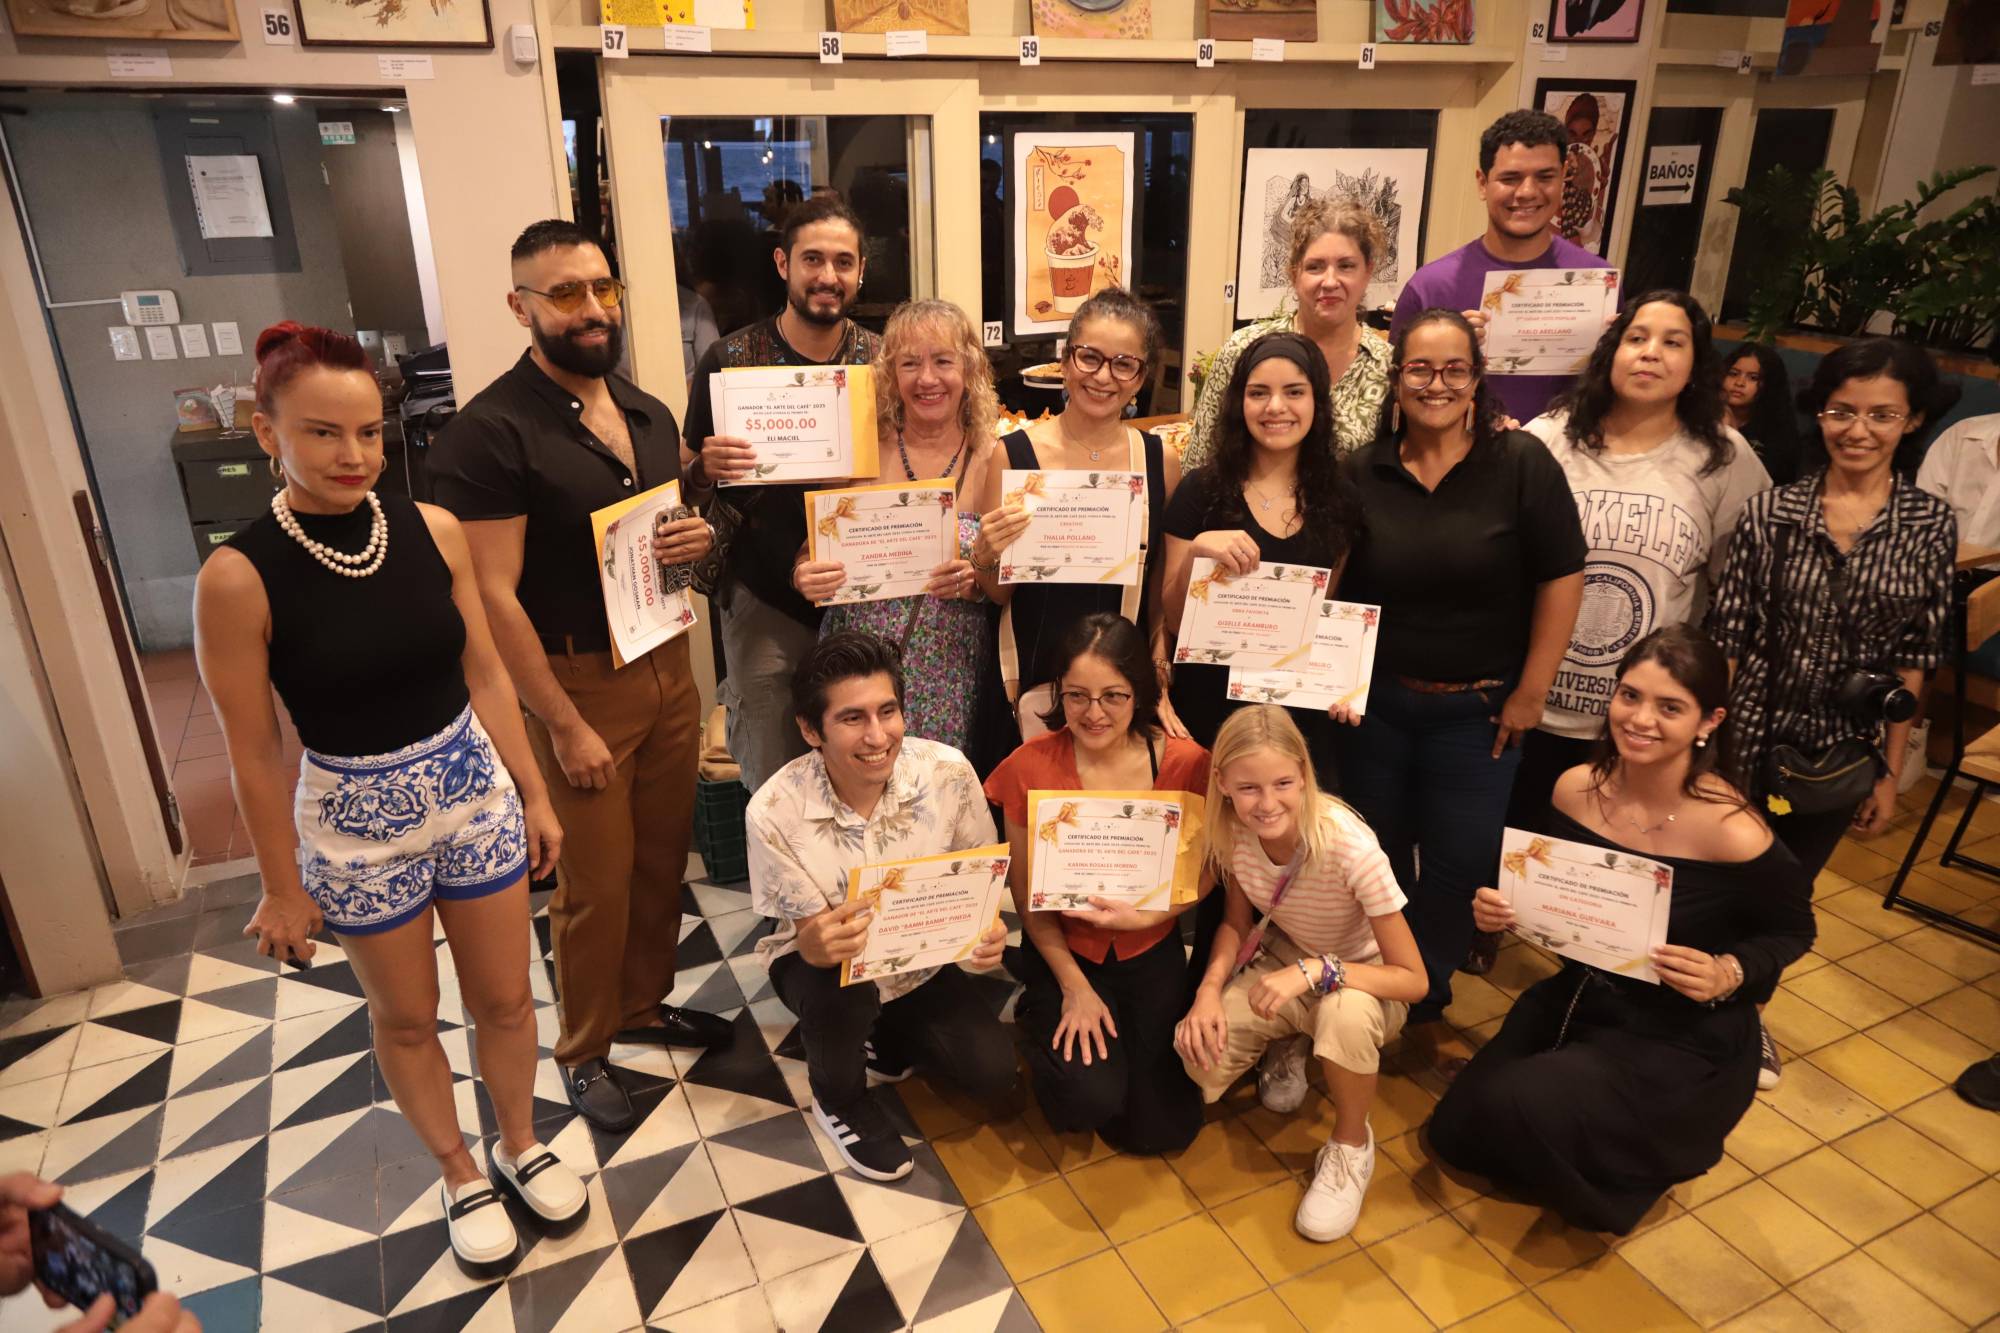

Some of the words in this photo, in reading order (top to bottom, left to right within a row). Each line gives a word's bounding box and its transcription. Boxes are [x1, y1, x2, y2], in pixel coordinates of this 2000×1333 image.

[265, 14, 291, 37] 56
[1532, 23, 1545, 39] 62
[1924, 20, 1942, 37] 65
[604, 30, 624, 50] 57
[822, 37, 840, 56] 58
[1021, 40, 1039, 59] 59
[1199, 43, 1214, 61] 60
[1361, 47, 1374, 64] 61
[1649, 160, 1695, 180] BAÑOS
[986, 324, 1001, 342] 72
[745, 418, 817, 432] $5,000.00
[848, 525, 882, 533] CERTIFICADO
[628, 546, 637, 581] JONATHAN
[861, 552, 888, 561] ZANDRA
[638, 534, 654, 607] $5,000.00
[1243, 622, 1279, 630] ARAMBURO
[1110, 834, 1144, 842] PREMIACIÓN
[1538, 873, 1578, 887] CERTIFICADO
[1588, 884, 1630, 899] PREMIACIÓN
[892, 895, 927, 906] CERTIFICADO
[936, 890, 969, 899] PREMIACIÓN
[878, 926, 900, 934] DAVID
[949, 913, 972, 922] PINEDA
[1541, 904, 1577, 918] MARIANA
[1579, 912, 1617, 928] GUEVARA
